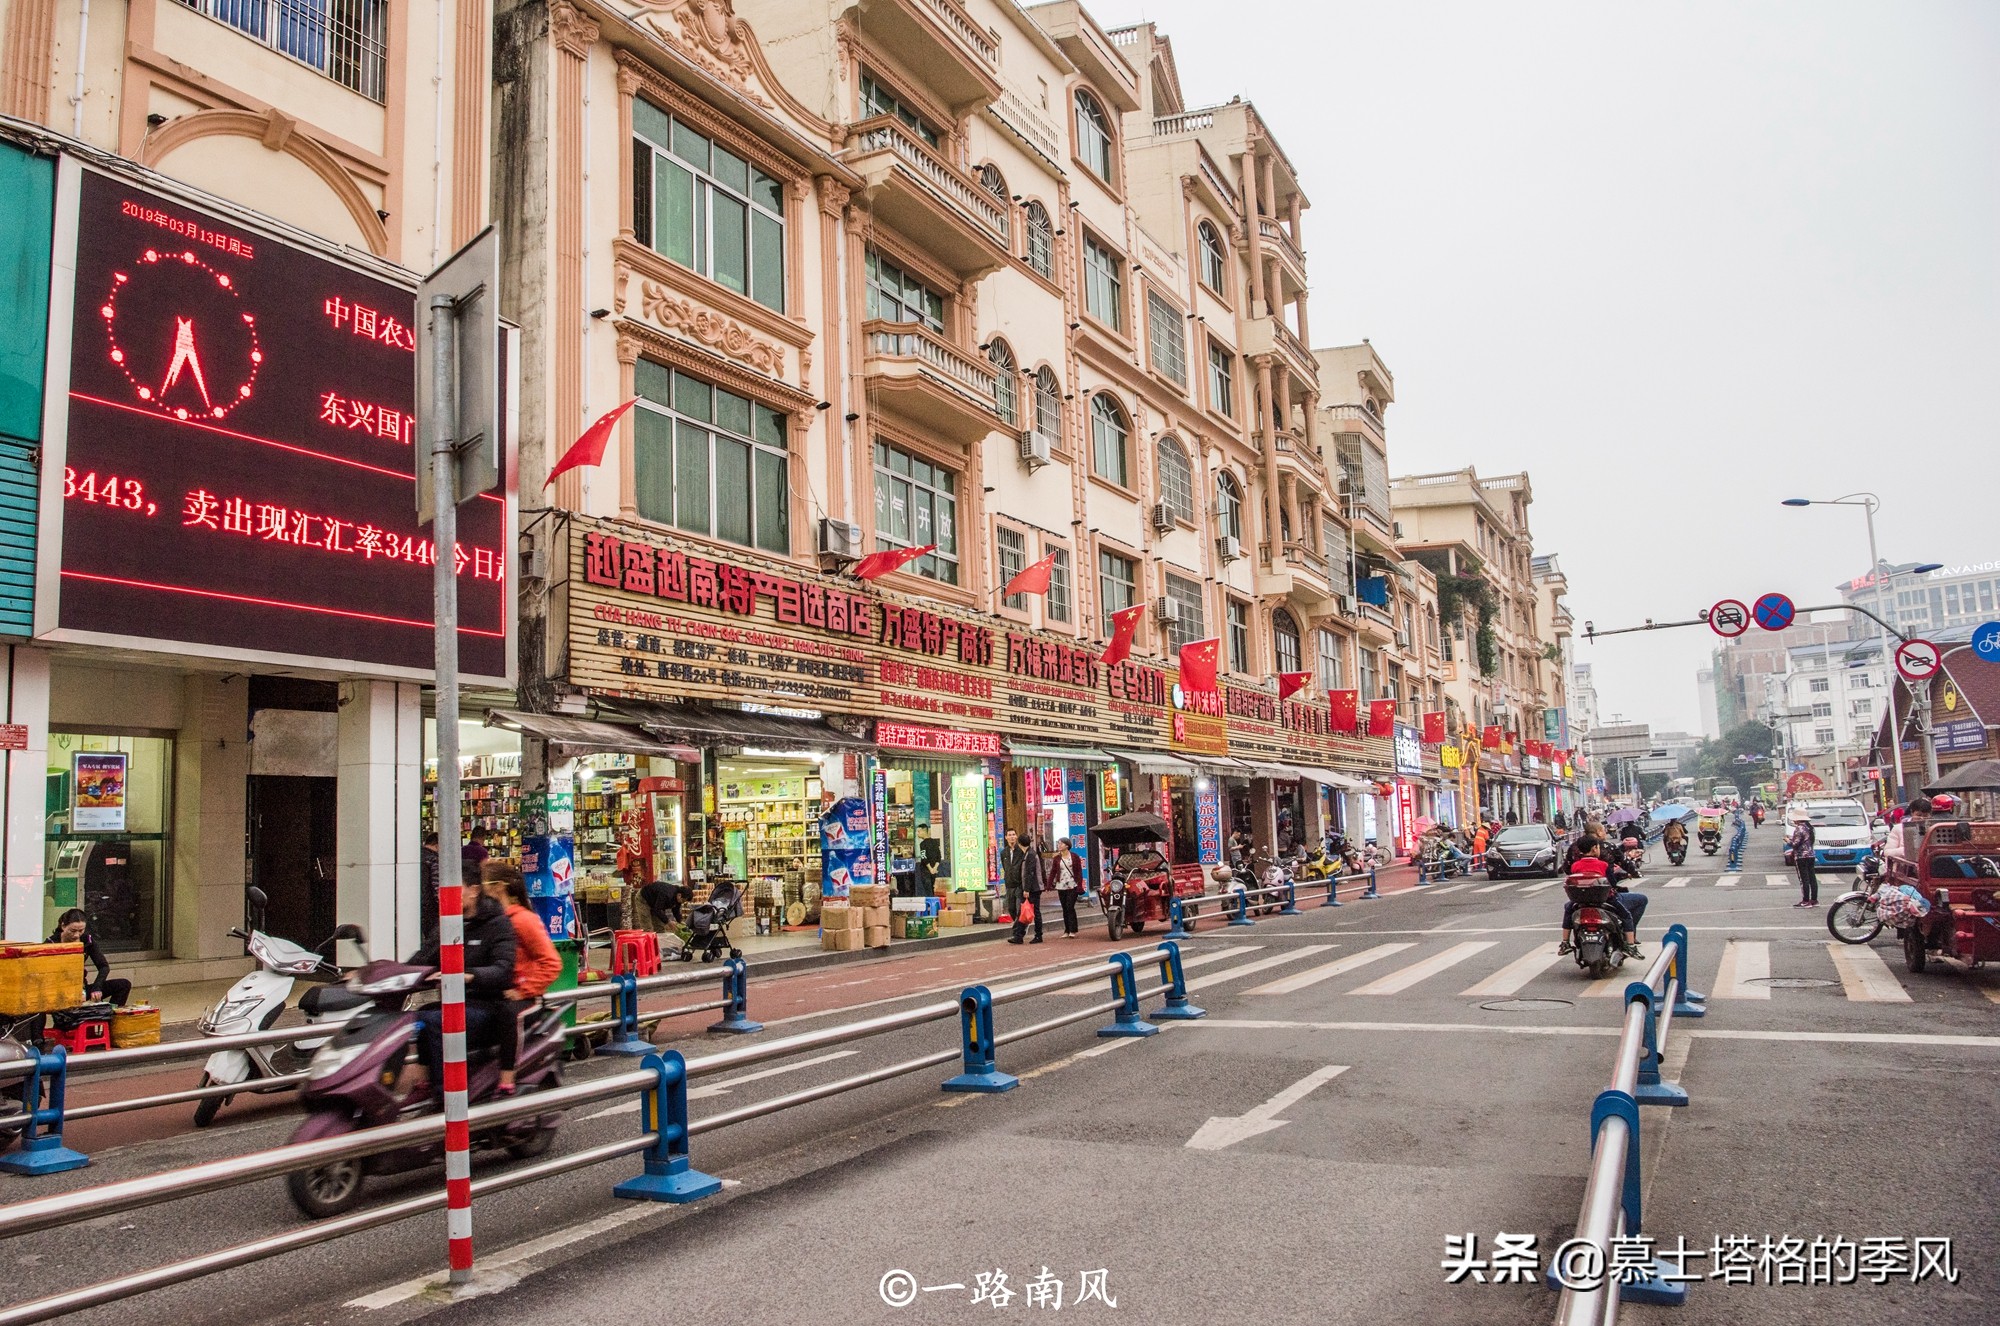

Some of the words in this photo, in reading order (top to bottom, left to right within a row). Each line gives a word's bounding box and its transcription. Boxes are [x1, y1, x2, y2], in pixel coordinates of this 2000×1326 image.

[122, 201, 254, 259] 2019年03月13日周三
[586, 532, 872, 637] 越盛越南特产自选商店
[880, 602, 995, 666] 万盛特产商行
[1006, 632, 1100, 689] 万福来珠宝行
[1043, 768, 1062, 791] 烟
